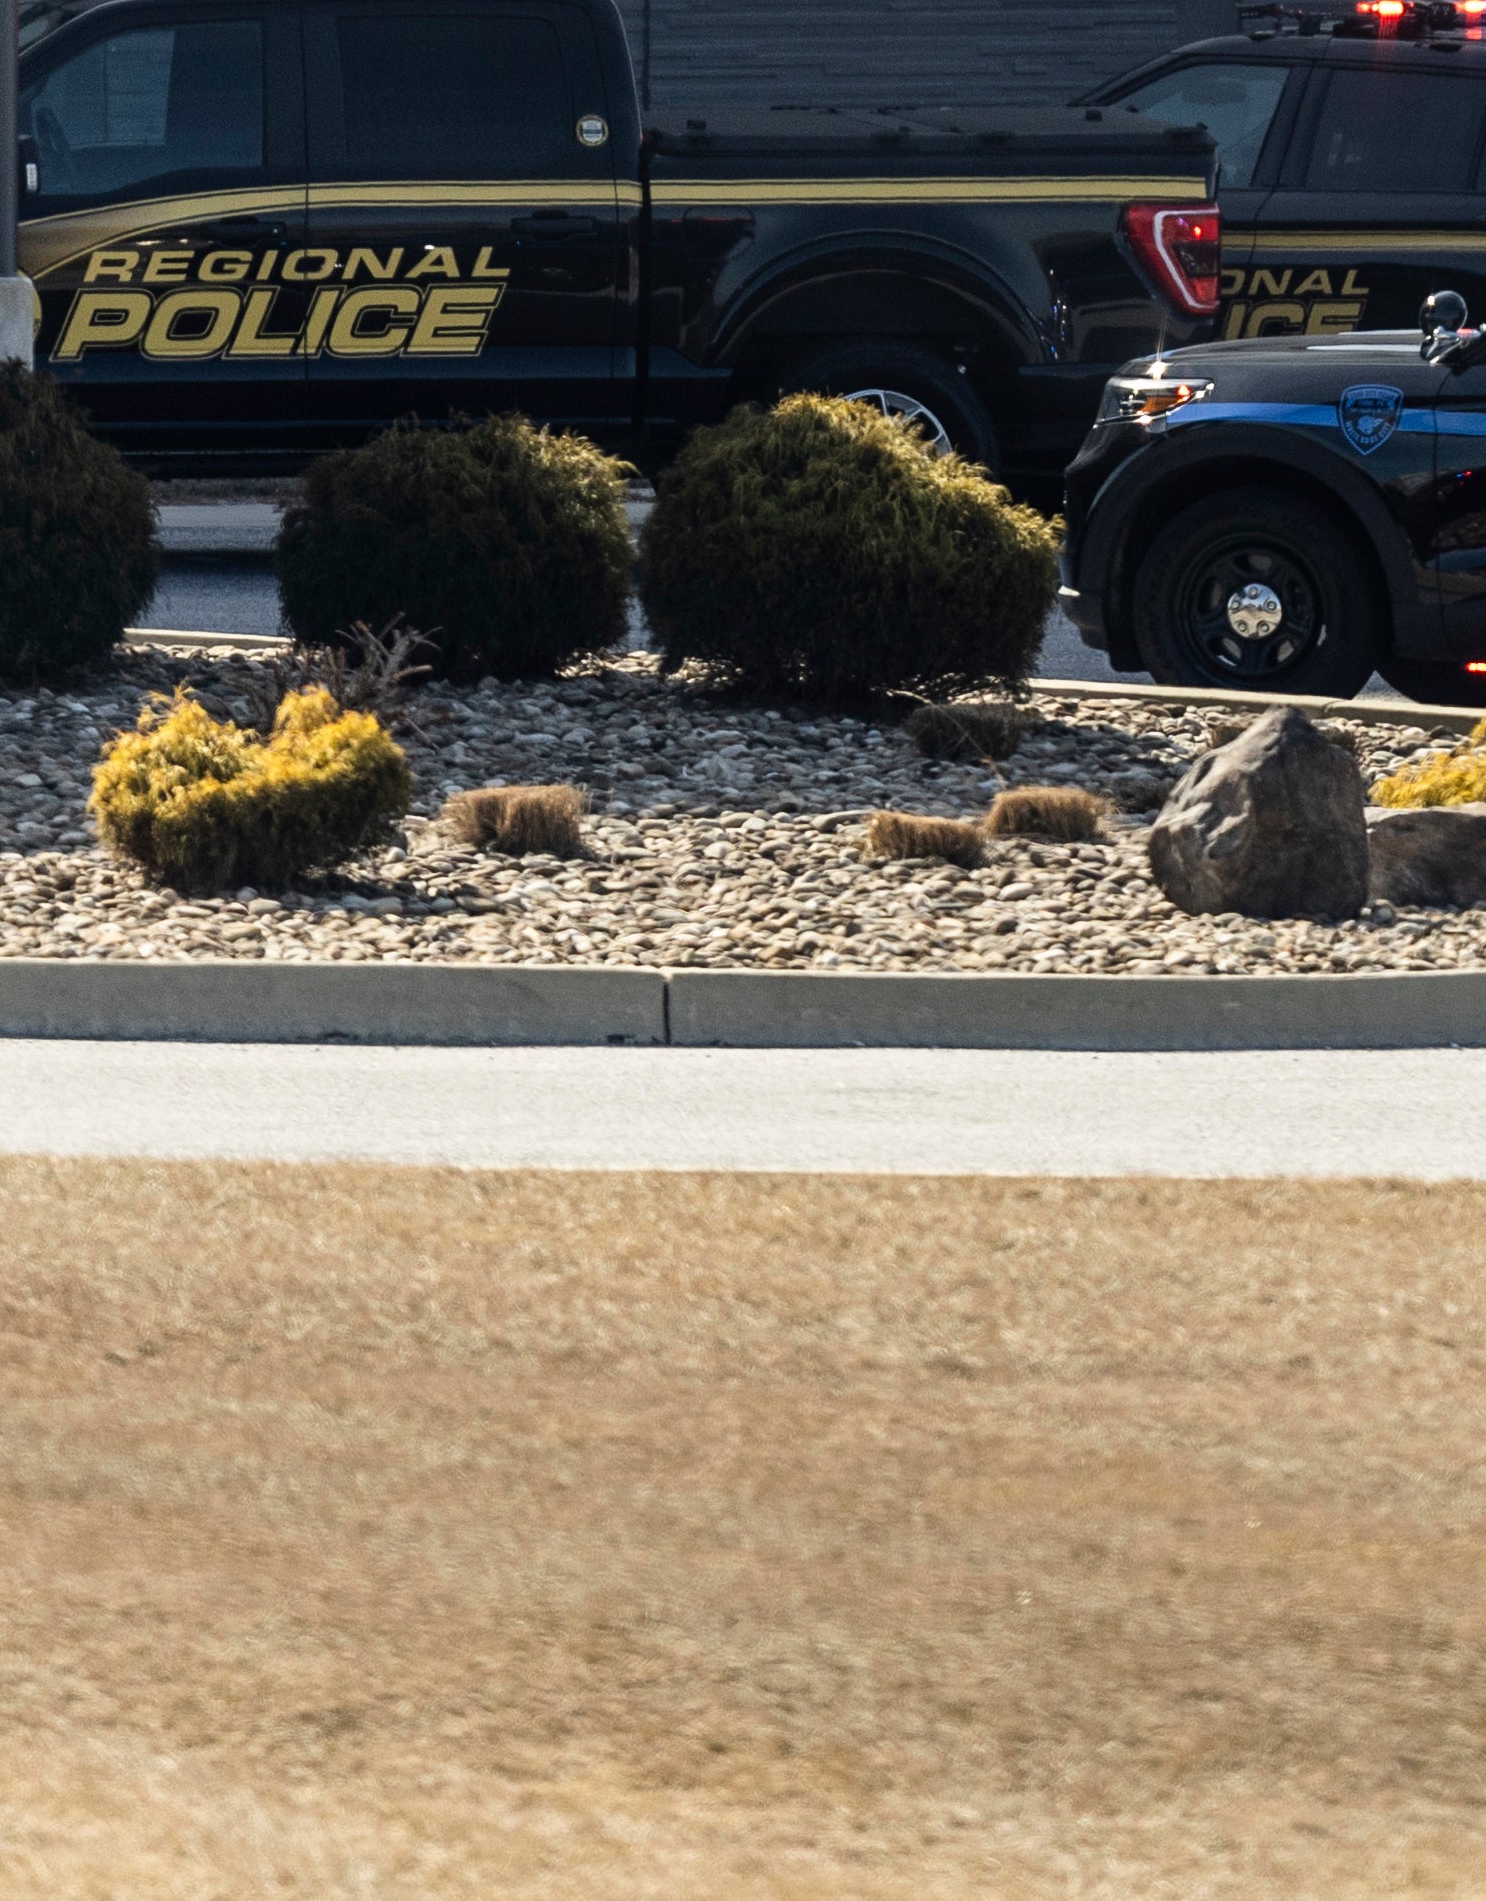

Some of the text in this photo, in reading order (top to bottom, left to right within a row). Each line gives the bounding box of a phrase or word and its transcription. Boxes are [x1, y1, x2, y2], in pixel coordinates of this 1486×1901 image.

[84, 246, 512, 283] REGIONAL
[1220, 268, 1371, 296] ONAL
[49, 281, 508, 363] POLICE
